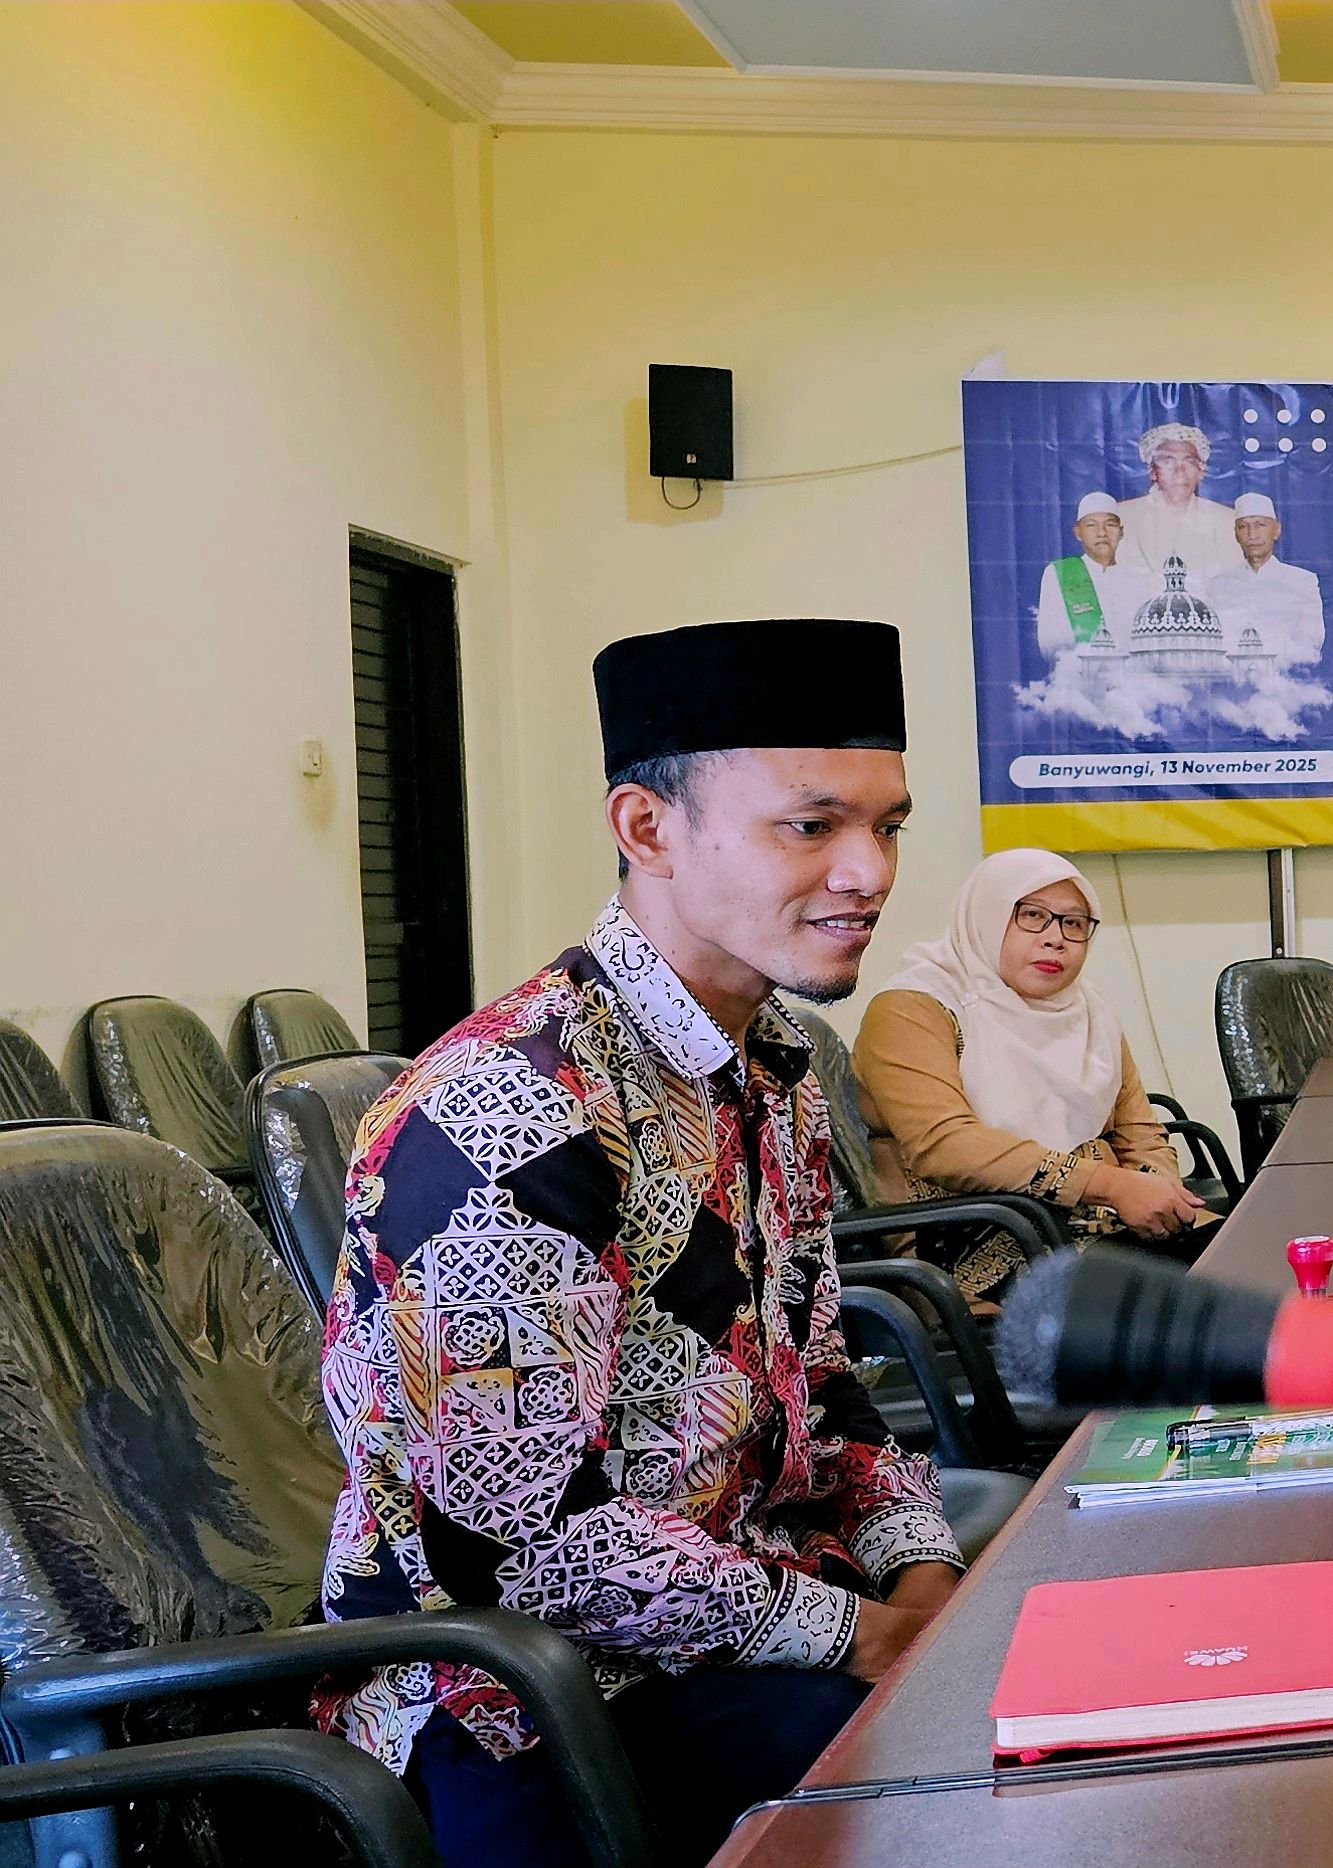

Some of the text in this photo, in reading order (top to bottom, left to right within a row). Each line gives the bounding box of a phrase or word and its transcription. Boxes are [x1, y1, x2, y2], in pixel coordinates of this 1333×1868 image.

[1038, 758, 1317, 779] Banyuwangi, 13 November 2025
